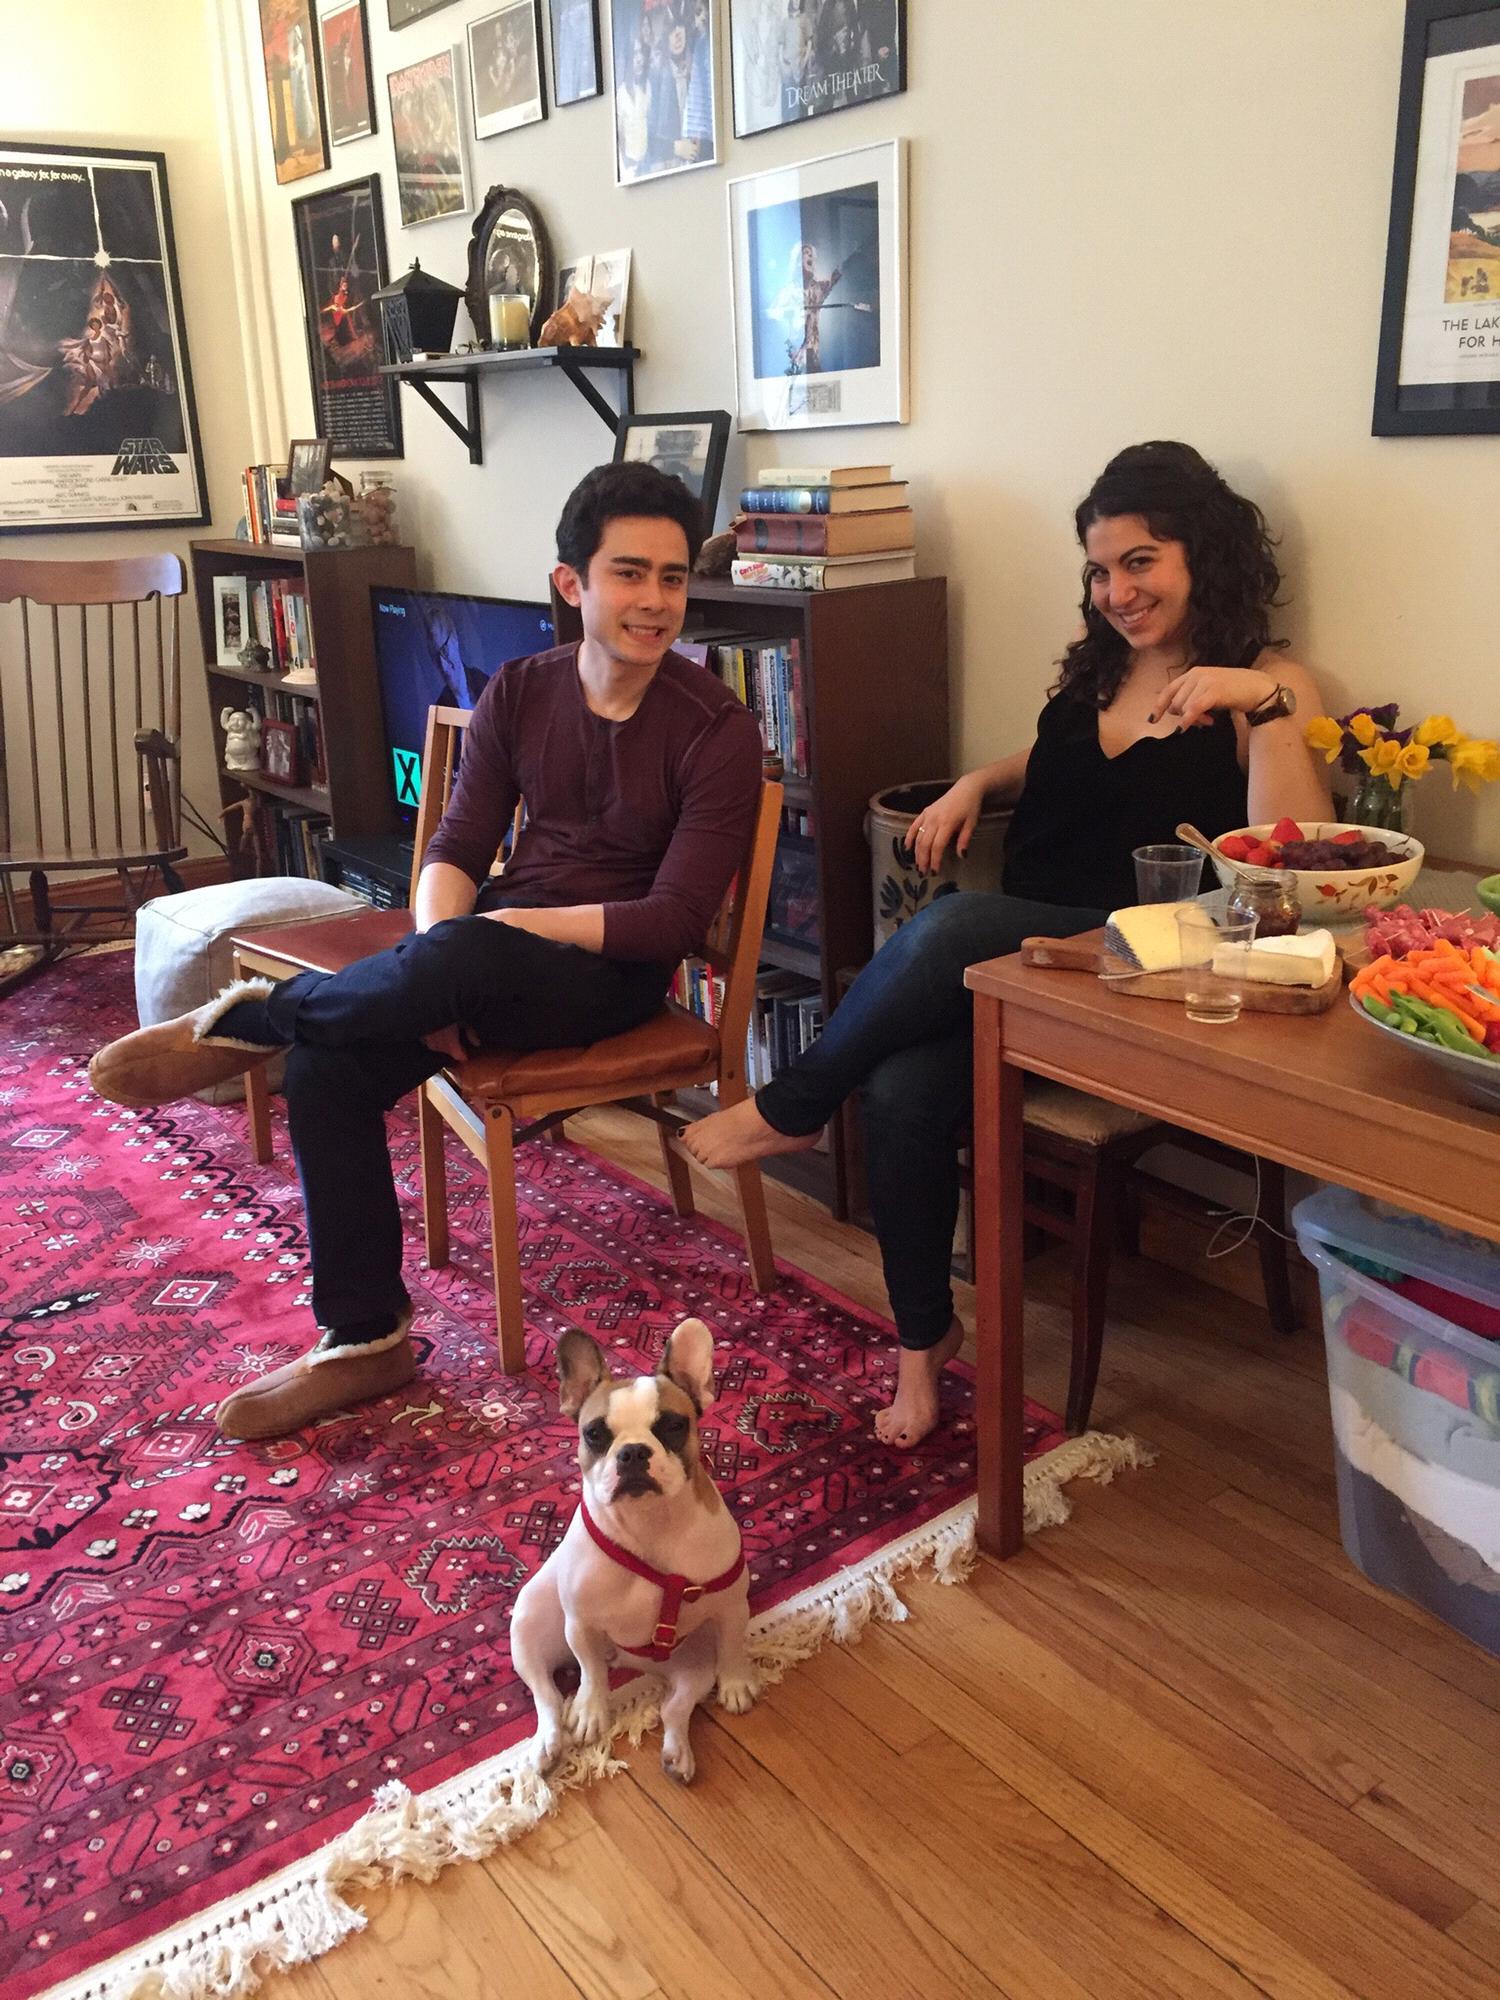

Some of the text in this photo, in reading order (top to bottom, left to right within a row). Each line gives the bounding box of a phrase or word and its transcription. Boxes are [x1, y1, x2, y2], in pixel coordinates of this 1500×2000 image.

[785, 63, 885, 108] DREAM THEATER
[1442, 318, 1469, 331] THE
[1459, 335, 1486, 348] FOR
[119, 438, 168, 455] STAR
[110, 455, 180, 475] WARS
[379, 603, 406, 617] Now Playing
